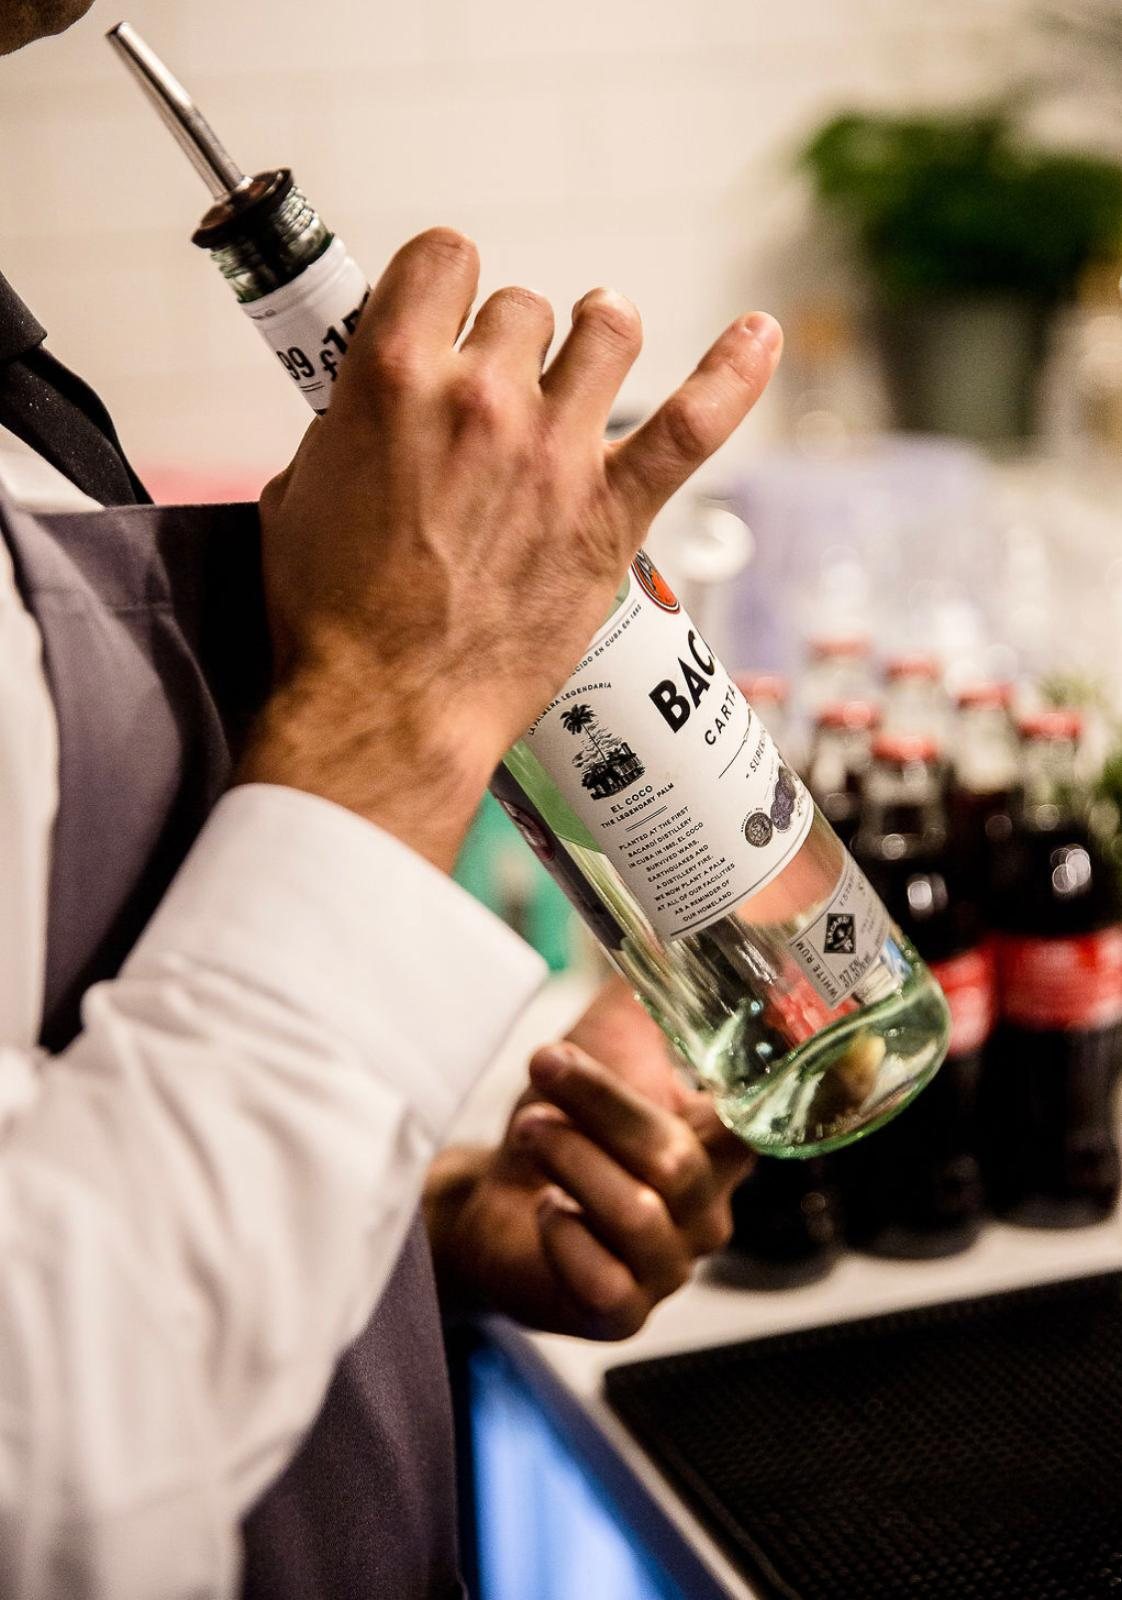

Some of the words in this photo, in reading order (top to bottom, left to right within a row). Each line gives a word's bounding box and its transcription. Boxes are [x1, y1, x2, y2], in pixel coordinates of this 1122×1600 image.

[568, 655, 593, 677] CIDO
[594, 646, 605, 657] EN
[605, 629, 622, 647] CUBA
[621, 619, 631, 630] EN
[561, 682, 612, 701] LEGENDARIA
[648, 629, 716, 734] BAC
[600, 819, 615, 829] THE
[615, 796, 656, 822] LEGENDARY
[656, 782, 674, 798] PALM
[610, 803, 624, 814] EL
[625, 785, 653, 805] COCO
[618, 833, 648, 850] PLANTED
[649, 827, 658, 836] AT
[658, 819, 672, 829] THE
[671, 806, 689, 822] FIRST
[636, 853, 655, 865] CUBA
[685, 821, 704, 838] COCO
[657, 817, 692, 843] DISTILLERY
[645, 852, 678, 873] SURVIVED
[678, 839, 700, 854] WARS,
[647, 854, 695, 883] EARTHQUAKES
[695, 844, 709, 857] AND
[656, 904, 666, 912] AT
[667, 899, 680, 907] ALL
[679, 893, 688, 901] OF
[688, 885, 703, 896] OUR
[702, 863, 736, 888] FACILITIES
[661, 864, 697, 888] DISTILLERY
[665, 887, 681, 897] NOW
[681, 873, 702, 889] PLANT
[709, 857, 726, 872] PALM
[674, 907, 684, 916] AS
[690, 885, 721, 907] REMINDER
[721, 879, 730, 888] OF
[682, 911, 696, 922] OUR
[795, 940, 814, 965] RUM
[812, 965, 838, 999] WHITE
